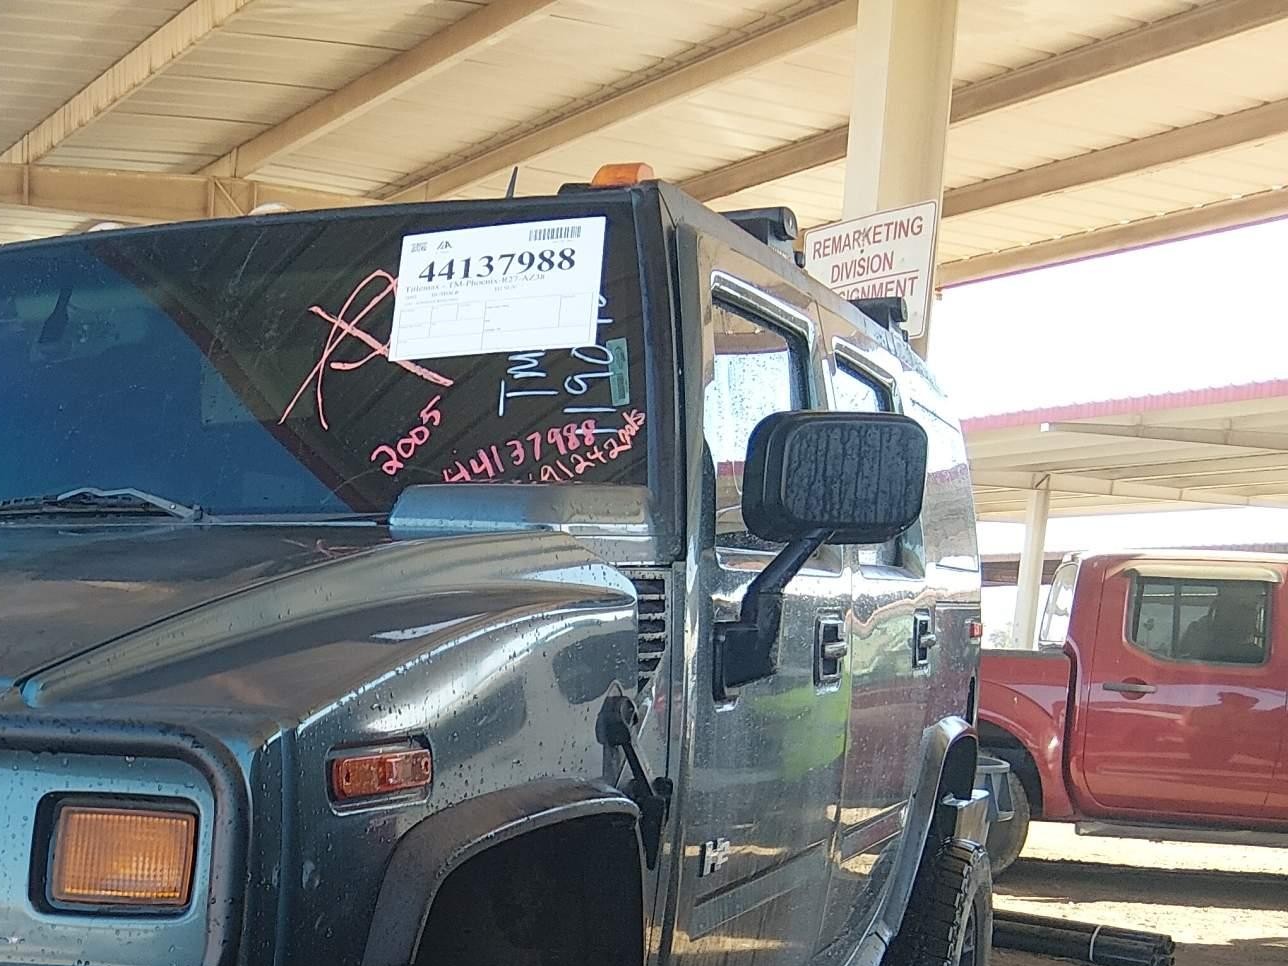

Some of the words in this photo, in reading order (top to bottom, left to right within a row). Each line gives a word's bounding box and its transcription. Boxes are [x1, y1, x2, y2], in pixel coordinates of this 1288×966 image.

[813, 216, 923, 260] REMARKETING
[419, 247, 576, 283] 44137988
[831, 251, 894, 284] DIVISION
[371, 395, 441, 475] 2005
[442, 418, 597, 482] 44137988
